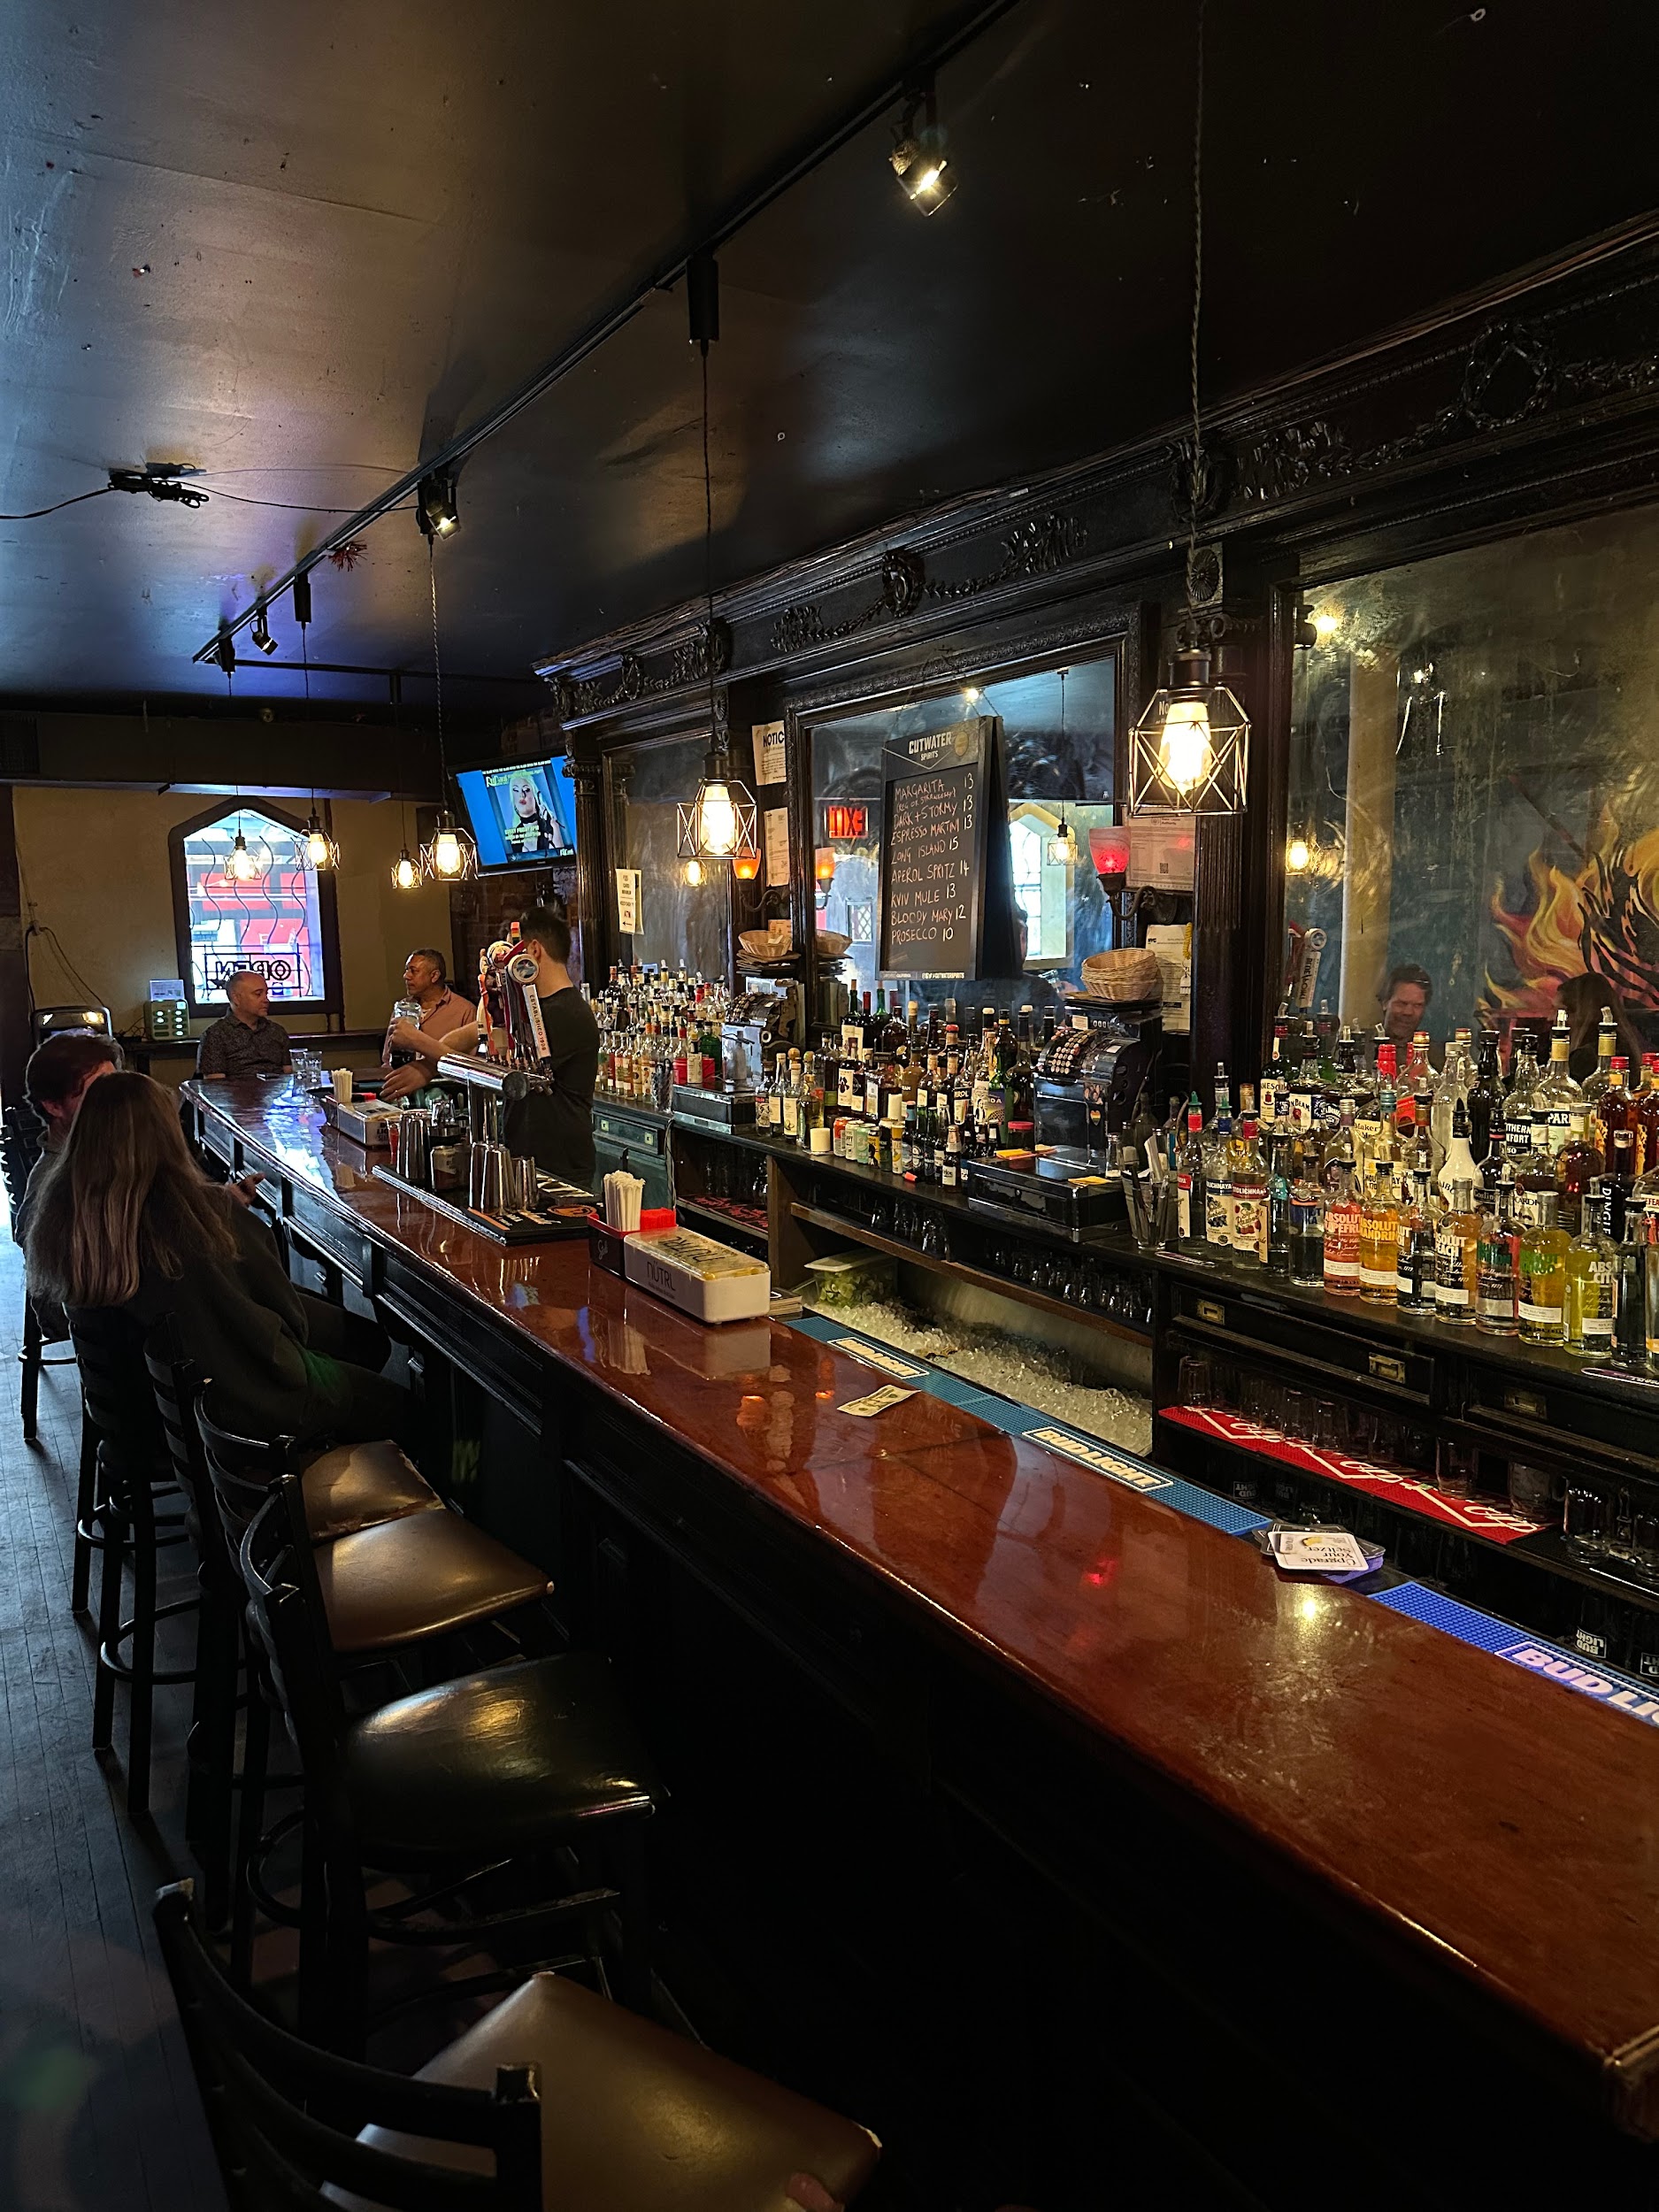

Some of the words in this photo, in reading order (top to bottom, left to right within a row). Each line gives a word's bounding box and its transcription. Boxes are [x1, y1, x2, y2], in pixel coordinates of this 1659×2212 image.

[763, 731, 785, 748] NOTIC
[908, 732, 952, 755] CUTWATER
[920, 750, 939, 761] SPIRITS
[895, 779, 945, 802] MARGARITA
[964, 772, 974, 789] 13
[894, 810, 914, 830] DARK
[963, 795, 973, 811] 13
[890, 825, 927, 846] ESPRESSO
[930, 818, 960, 836] MARTINI
[964, 814, 972, 830] 13
[891, 847, 911, 864] LONG
[918, 839, 946, 858] ISLAND
[949, 835, 959, 850] 15
[891, 867, 924, 885] APEROL
[926, 863, 955, 880] SPRITZ
[960, 859, 970, 877] 14
[914, 889, 940, 907] MULE
[946, 882, 956, 899] 13
[891, 910, 927, 926] BLOODY
[932, 908, 953, 926] MARY
[956, 904, 966, 921] 12
[891, 926, 937, 946] PROSECCO
[942, 926, 954, 941] 10
[1548, 1113, 1570, 1125] PAR
[1325, 1210, 1361, 1225] ABSOLUT
[1435, 1233, 1467, 1247] SOLUT
[1033, 1429, 1089, 1455] BUD
[1079, 1450, 1162, 1487] LIGHT
[1301, 1557, 1356, 1566] Upgrade
[1576, 1629, 1604, 1647] LIGHT
[1576, 1640, 1599, 1655] BUD
[1512, 1647, 1614, 1694] BUD
[1606, 1690, 1659, 1724] LI
